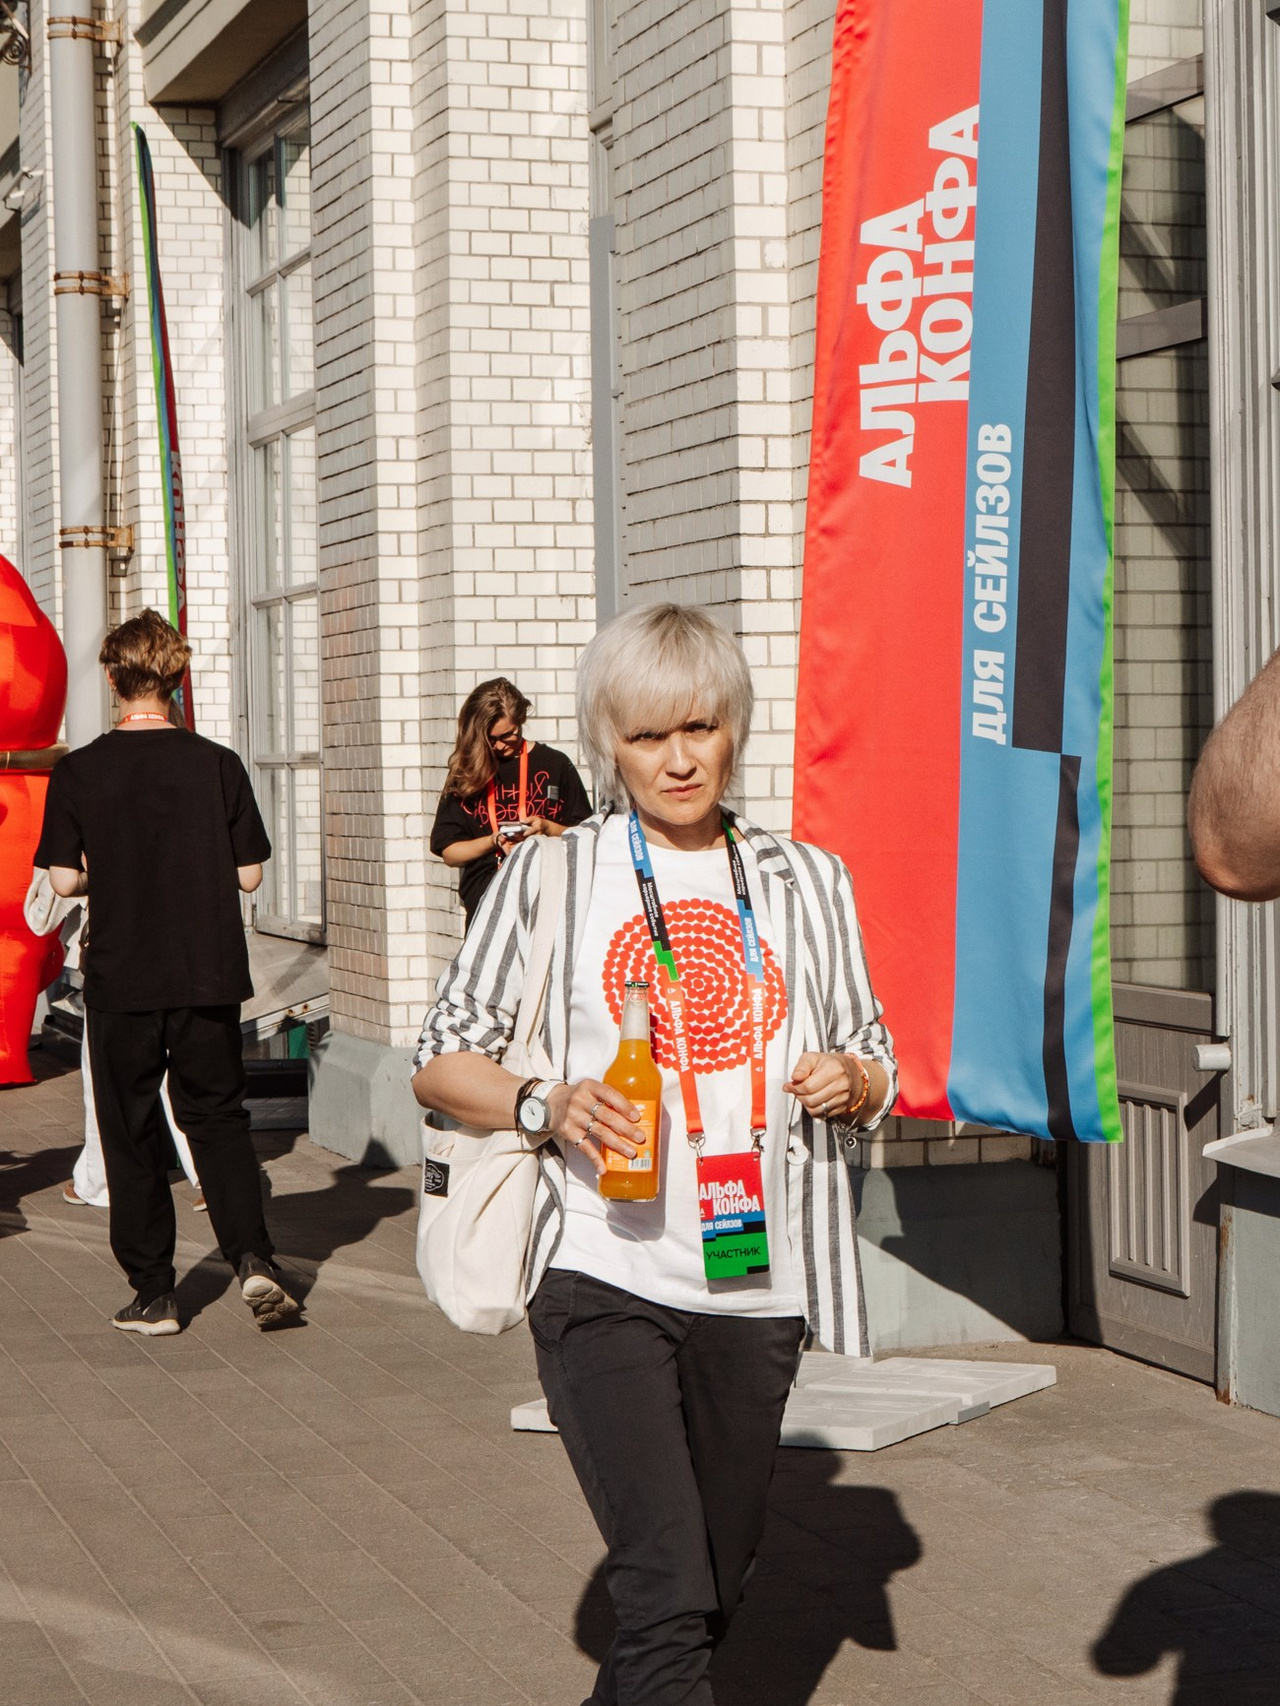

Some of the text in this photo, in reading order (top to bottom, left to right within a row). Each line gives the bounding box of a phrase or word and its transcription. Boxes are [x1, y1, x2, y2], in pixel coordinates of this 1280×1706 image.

[918, 104, 980, 402] КОНФА
[857, 198, 924, 489] АЛЬФА
[966, 423, 1012, 745] ДЛЯ СЕЙЛЗОВ
[669, 1000, 684, 1035] АЛЬФА
[752, 987, 763, 1025] КОНФА
[675, 1036, 690, 1073] КОНФА
[754, 1027, 764, 1060] АЛЬФА
[699, 1180, 747, 1200] АЛЬФА
[713, 1195, 761, 1216] КОНФА
[706, 1246, 761, 1260] УЧАСТНИК
